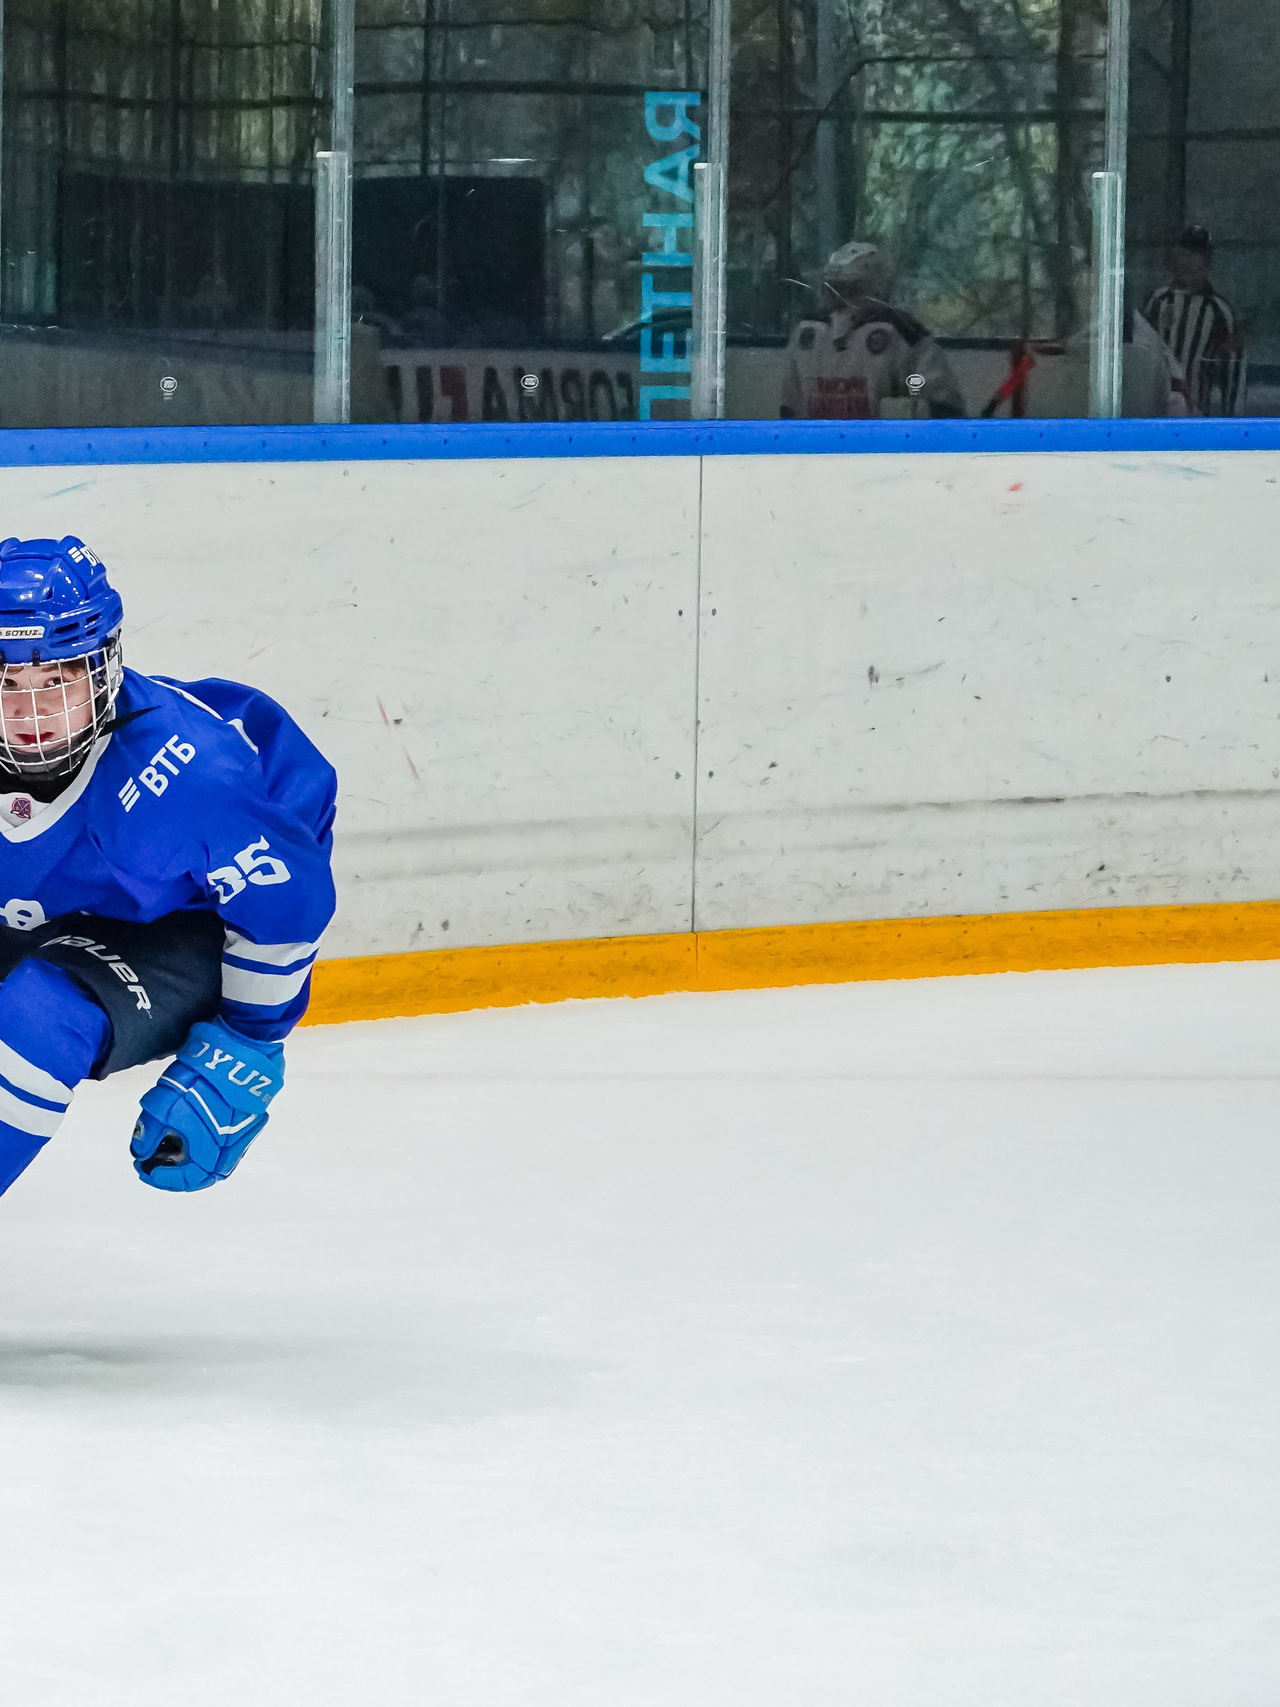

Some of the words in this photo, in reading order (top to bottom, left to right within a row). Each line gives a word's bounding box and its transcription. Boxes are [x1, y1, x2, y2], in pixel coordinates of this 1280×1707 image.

[5, 629, 38, 637] SOYUZ
[138, 734, 196, 798] ВТБ
[207, 835, 291, 905] 35
